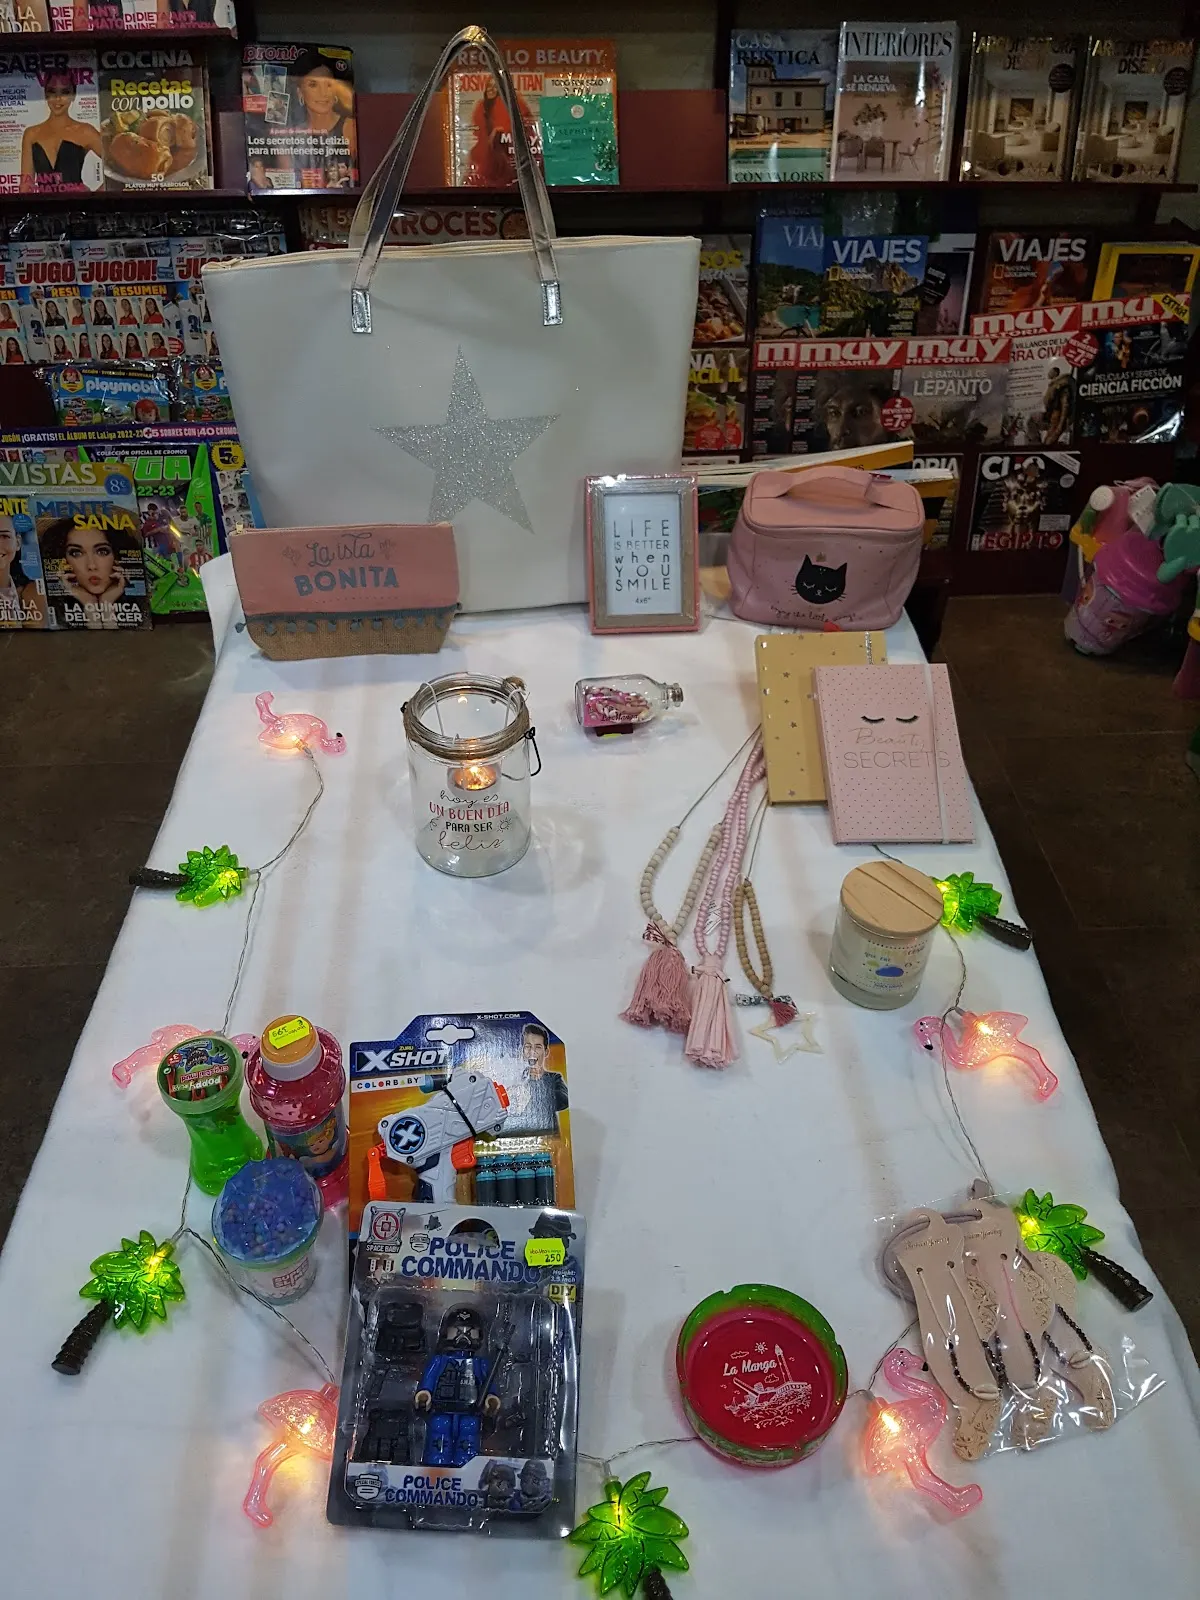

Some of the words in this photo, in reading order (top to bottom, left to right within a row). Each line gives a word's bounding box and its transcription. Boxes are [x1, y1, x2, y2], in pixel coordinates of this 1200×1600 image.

[18, 6, 36, 20] LA
[845, 31, 952, 57] INTERIORES
[101, 49, 194, 69] COCINA
[458, 50, 530, 66] REGLO
[536, 49, 605, 65] BEAUTY
[853, 75, 865, 83] LA
[867, 74, 890, 83] CASA
[111, 79, 193, 97] Recetas
[846, 83, 857, 91] SE
[857, 83, 898, 92] RENUEVA
[111, 97, 141, 111] con
[142, 92, 194, 111] pollo
[248, 136, 265, 146] Los
[267, 136, 305, 146] secretos
[306, 136, 318, 145] de
[320, 136, 350, 146] Letizia
[248, 148, 269, 157] para
[270, 147, 324, 156] mantenerse
[325, 147, 351, 157] joven
[151, 173, 165, 182] 50
[735, 171, 762, 182] CON
[390, 210, 497, 236] RROCES
[832, 239, 922, 264] VIAJES
[999, 237, 1088, 263] VIAJES
[112, 284, 168, 297] RESUMEN
[972, 305, 1076, 336] muy
[800, 341, 905, 366] muy
[906, 338, 1011, 364] muy
[799, 360, 876, 368] INTERESANTE
[905, 356, 981, 365] HISTORIA
[921, 371, 934, 379] LA
[935, 370, 970, 379] BATALLA
[913, 378, 993, 397] LEPANTO
[1078, 380, 1129, 397] CIENCIA
[1131, 374, 1183, 393] FICCIÓN
[21, 432, 58, 443] ¡GRATIS!
[58, 432, 66, 441] EL
[87, 430, 97, 440] DE
[160, 427, 181, 437] SOBRES
[182, 427, 196, 437] CON
[96, 449, 131, 457] COLECCIÓN
[136, 485, 176, 497] 22-23
[36, 500, 114, 518] MENTE
[72, 513, 137, 532] SANA
[613, 519, 670, 538] LIFE
[614, 540, 622, 550] IS
[626, 539, 670, 550] BETTER
[305, 542, 335, 568] La
[615, 552, 671, 564] when
[615, 564, 671, 578] YOU
[294, 566, 400, 597] BONITA
[615, 578, 671, 592] SMILE
[22, 600, 38, 610] LA
[64, 602, 83, 613] LA
[84, 600, 141, 613] QUÍMICA
[64, 613, 89, 623] DEL
[93, 613, 143, 623] PLACER
[848, 727, 926, 752] Beauty
[843, 751, 951, 769] SECRETS
[440, 789, 478, 808] hoy
[483, 793, 499, 802] es
[429, 801, 445, 817] UN
[448, 807, 483, 820] BUEN
[445, 821, 470, 832] PARA
[473, 822, 493, 832] SER
[438, 830, 504, 850] feliz
[476, 1012, 521, 1020] X-SHOT.COM
[366, 1244, 384, 1252] SPACE
[401, 1256, 541, 1284] COMMANDO
[551, 1284, 575, 1296] DIY
[722, 1362, 738, 1377] La
[741, 1358, 778, 1374] Manga
[403, 1474, 462, 1492] POLICE
[385, 1488, 479, 1507] COMMANDO
